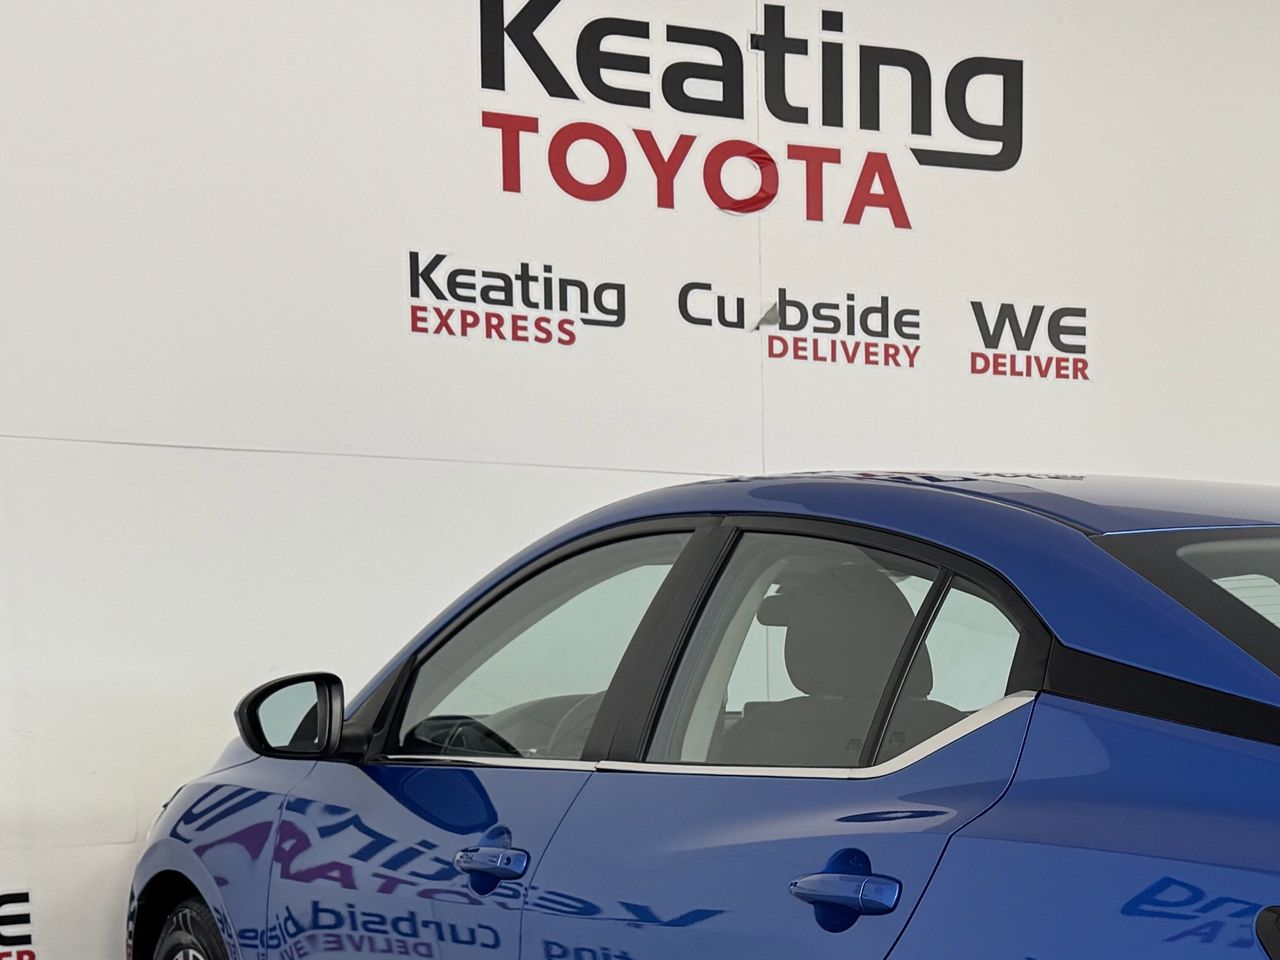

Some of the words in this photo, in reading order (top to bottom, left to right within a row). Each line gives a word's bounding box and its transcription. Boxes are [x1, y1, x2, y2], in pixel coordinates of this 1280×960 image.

[480, 0, 1024, 171] Keating
[481, 111, 912, 229] TOYOTA
[409, 251, 626, 328] Keating
[677, 282, 921, 342] Cubside
[409, 306, 577, 345] EXPRESS
[767, 335, 921, 369] DELIVERY
[970, 301, 1088, 355] WE
[970, 352, 1090, 381] DELIVER
